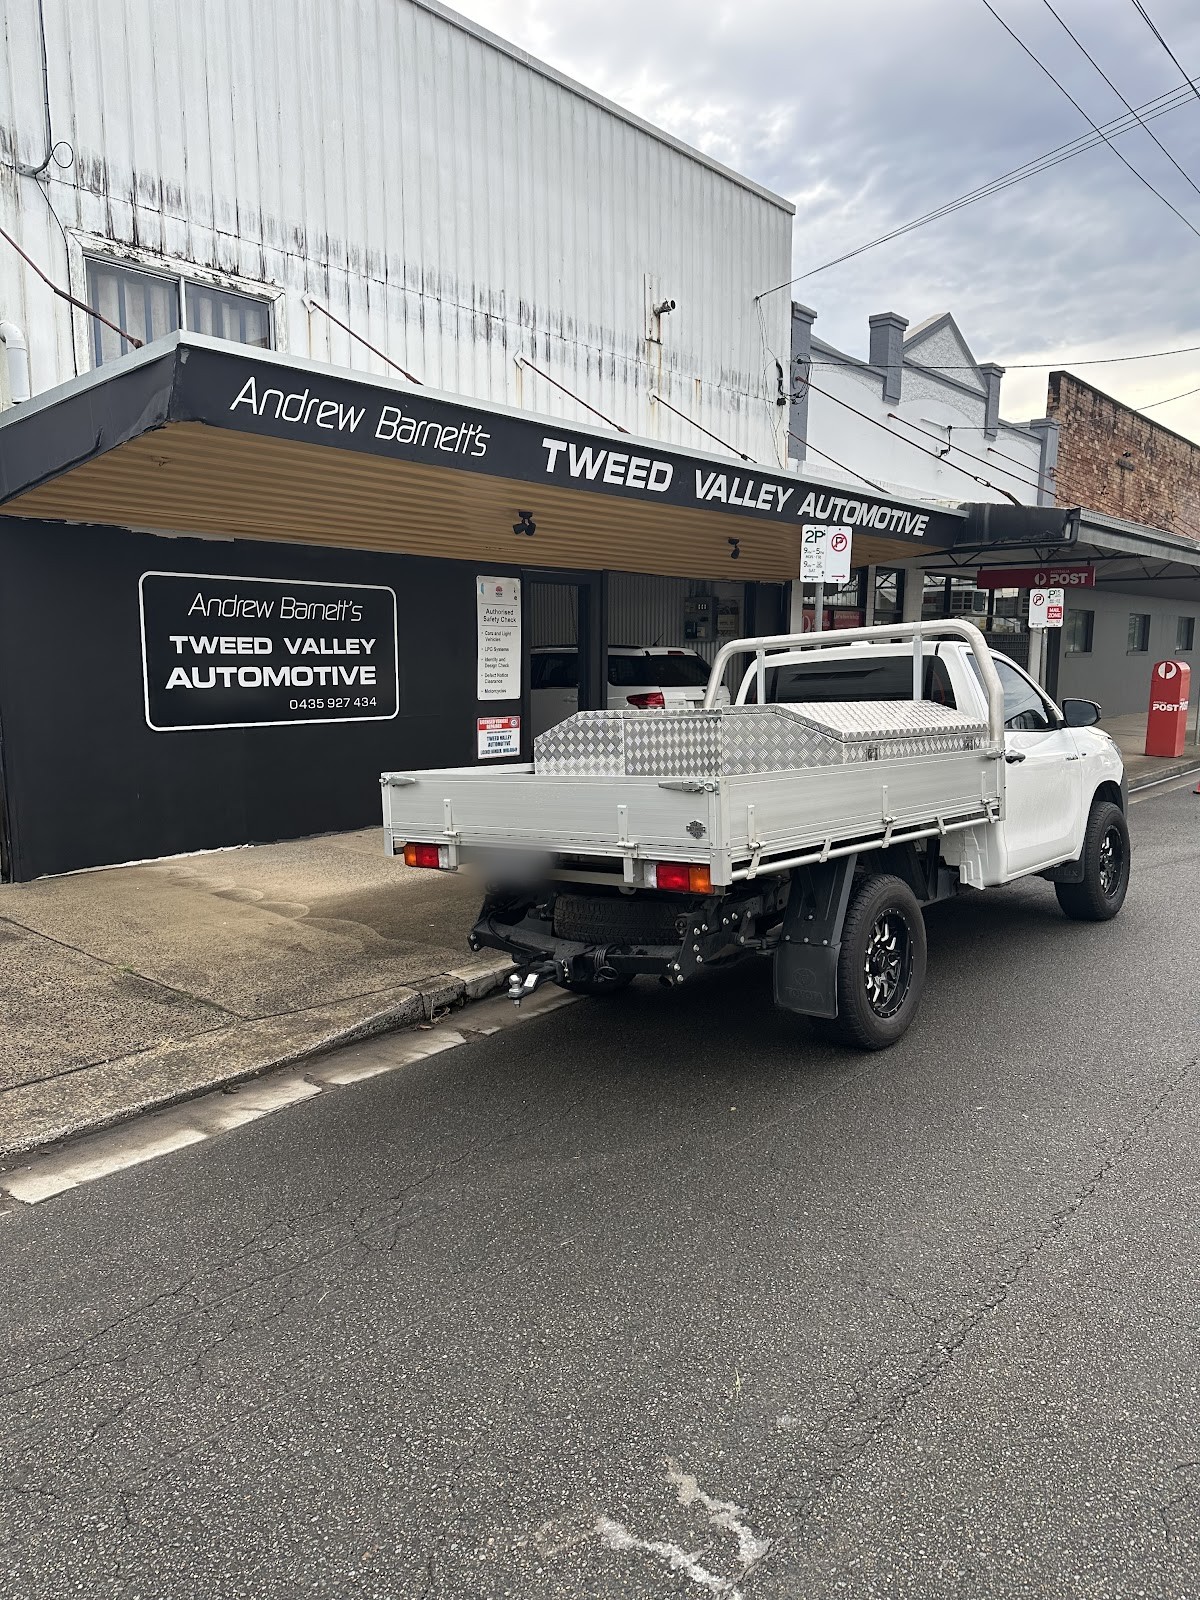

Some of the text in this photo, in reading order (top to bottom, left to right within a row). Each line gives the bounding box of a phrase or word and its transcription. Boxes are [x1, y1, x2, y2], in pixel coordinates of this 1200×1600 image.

[229, 376, 930, 537] Andrew Barnett's TWEED VALLEY AUTOMOTIVE
[1050, 573, 1088, 585] POST
[188, 592, 364, 622] Andrew Barnett's
[485, 608, 514, 616] Authorised
[483, 615, 500, 624] Safety
[169, 635, 376, 655] TWEED VALLEY
[165, 665, 377, 690] AUTOMOTIVE
[289, 697, 377, 710] 0435 927 434
[1152, 703, 1180, 712] POST
